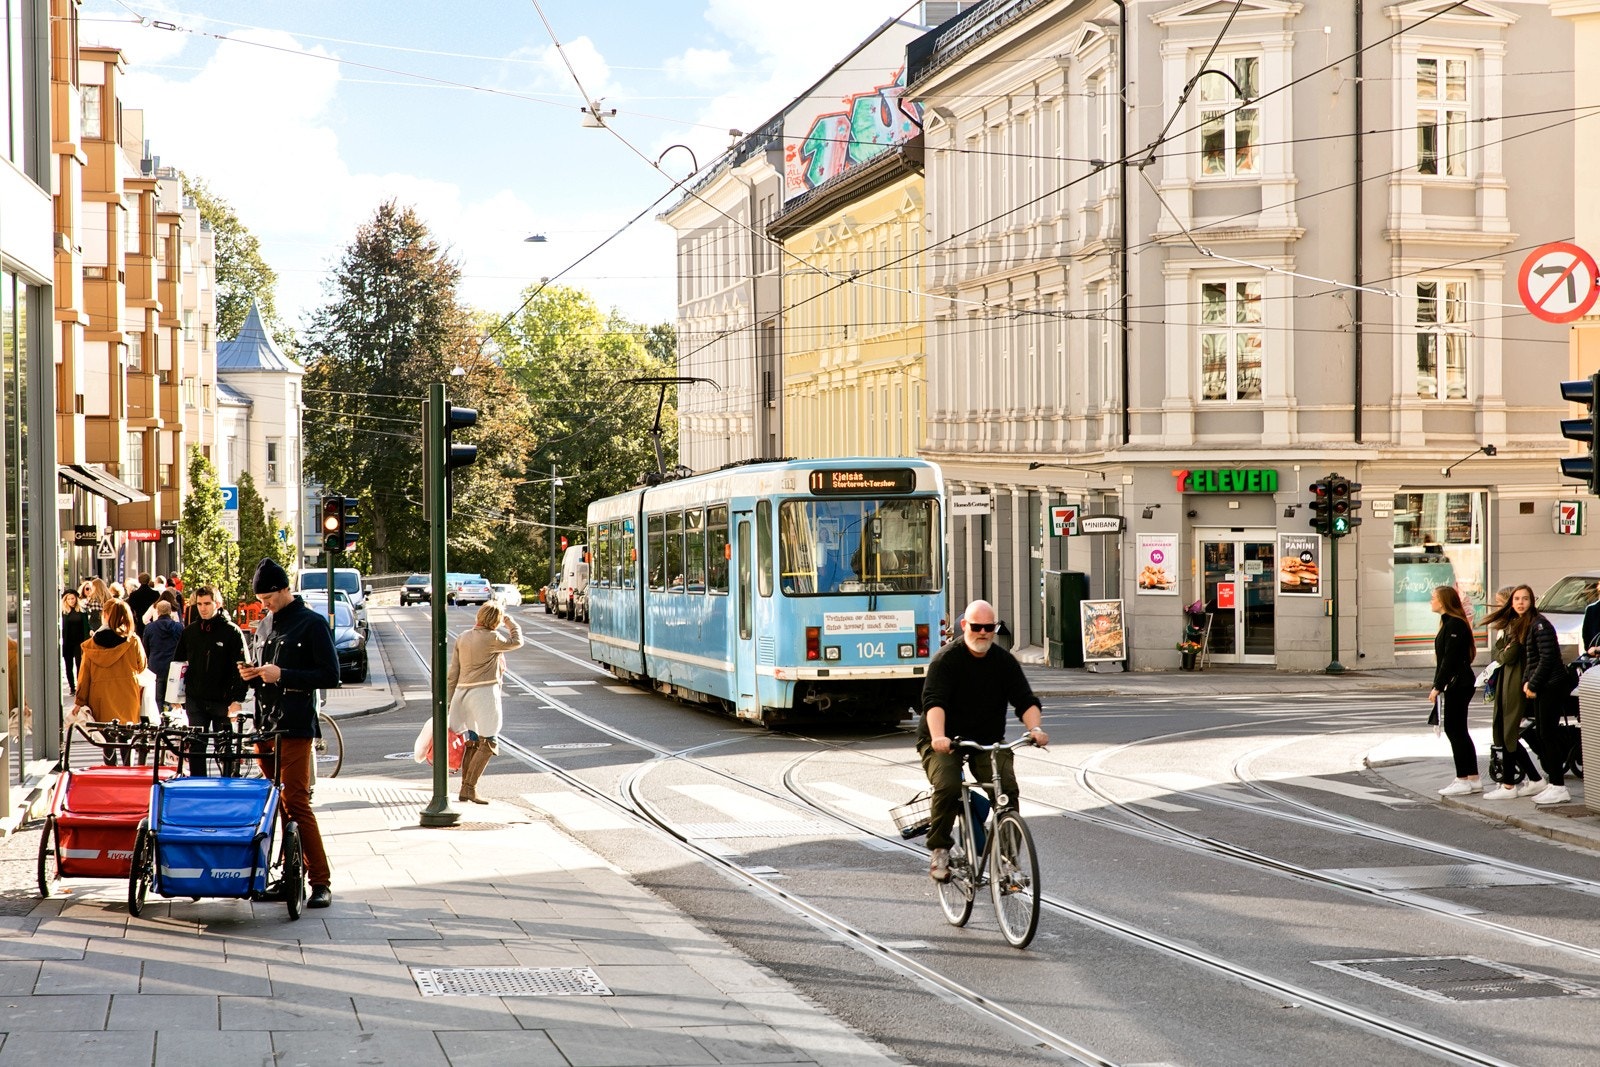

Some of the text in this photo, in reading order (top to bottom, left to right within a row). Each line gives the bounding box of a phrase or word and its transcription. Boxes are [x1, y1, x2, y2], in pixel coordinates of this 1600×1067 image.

[811, 473, 823, 489] 11
[832, 472, 864, 481] Kjelsås
[1085, 521, 1118, 529] MINIBANK
[75, 531, 97, 540] GARBO
[130, 530, 153, 539] Triumph
[856, 641, 886, 659] 104
